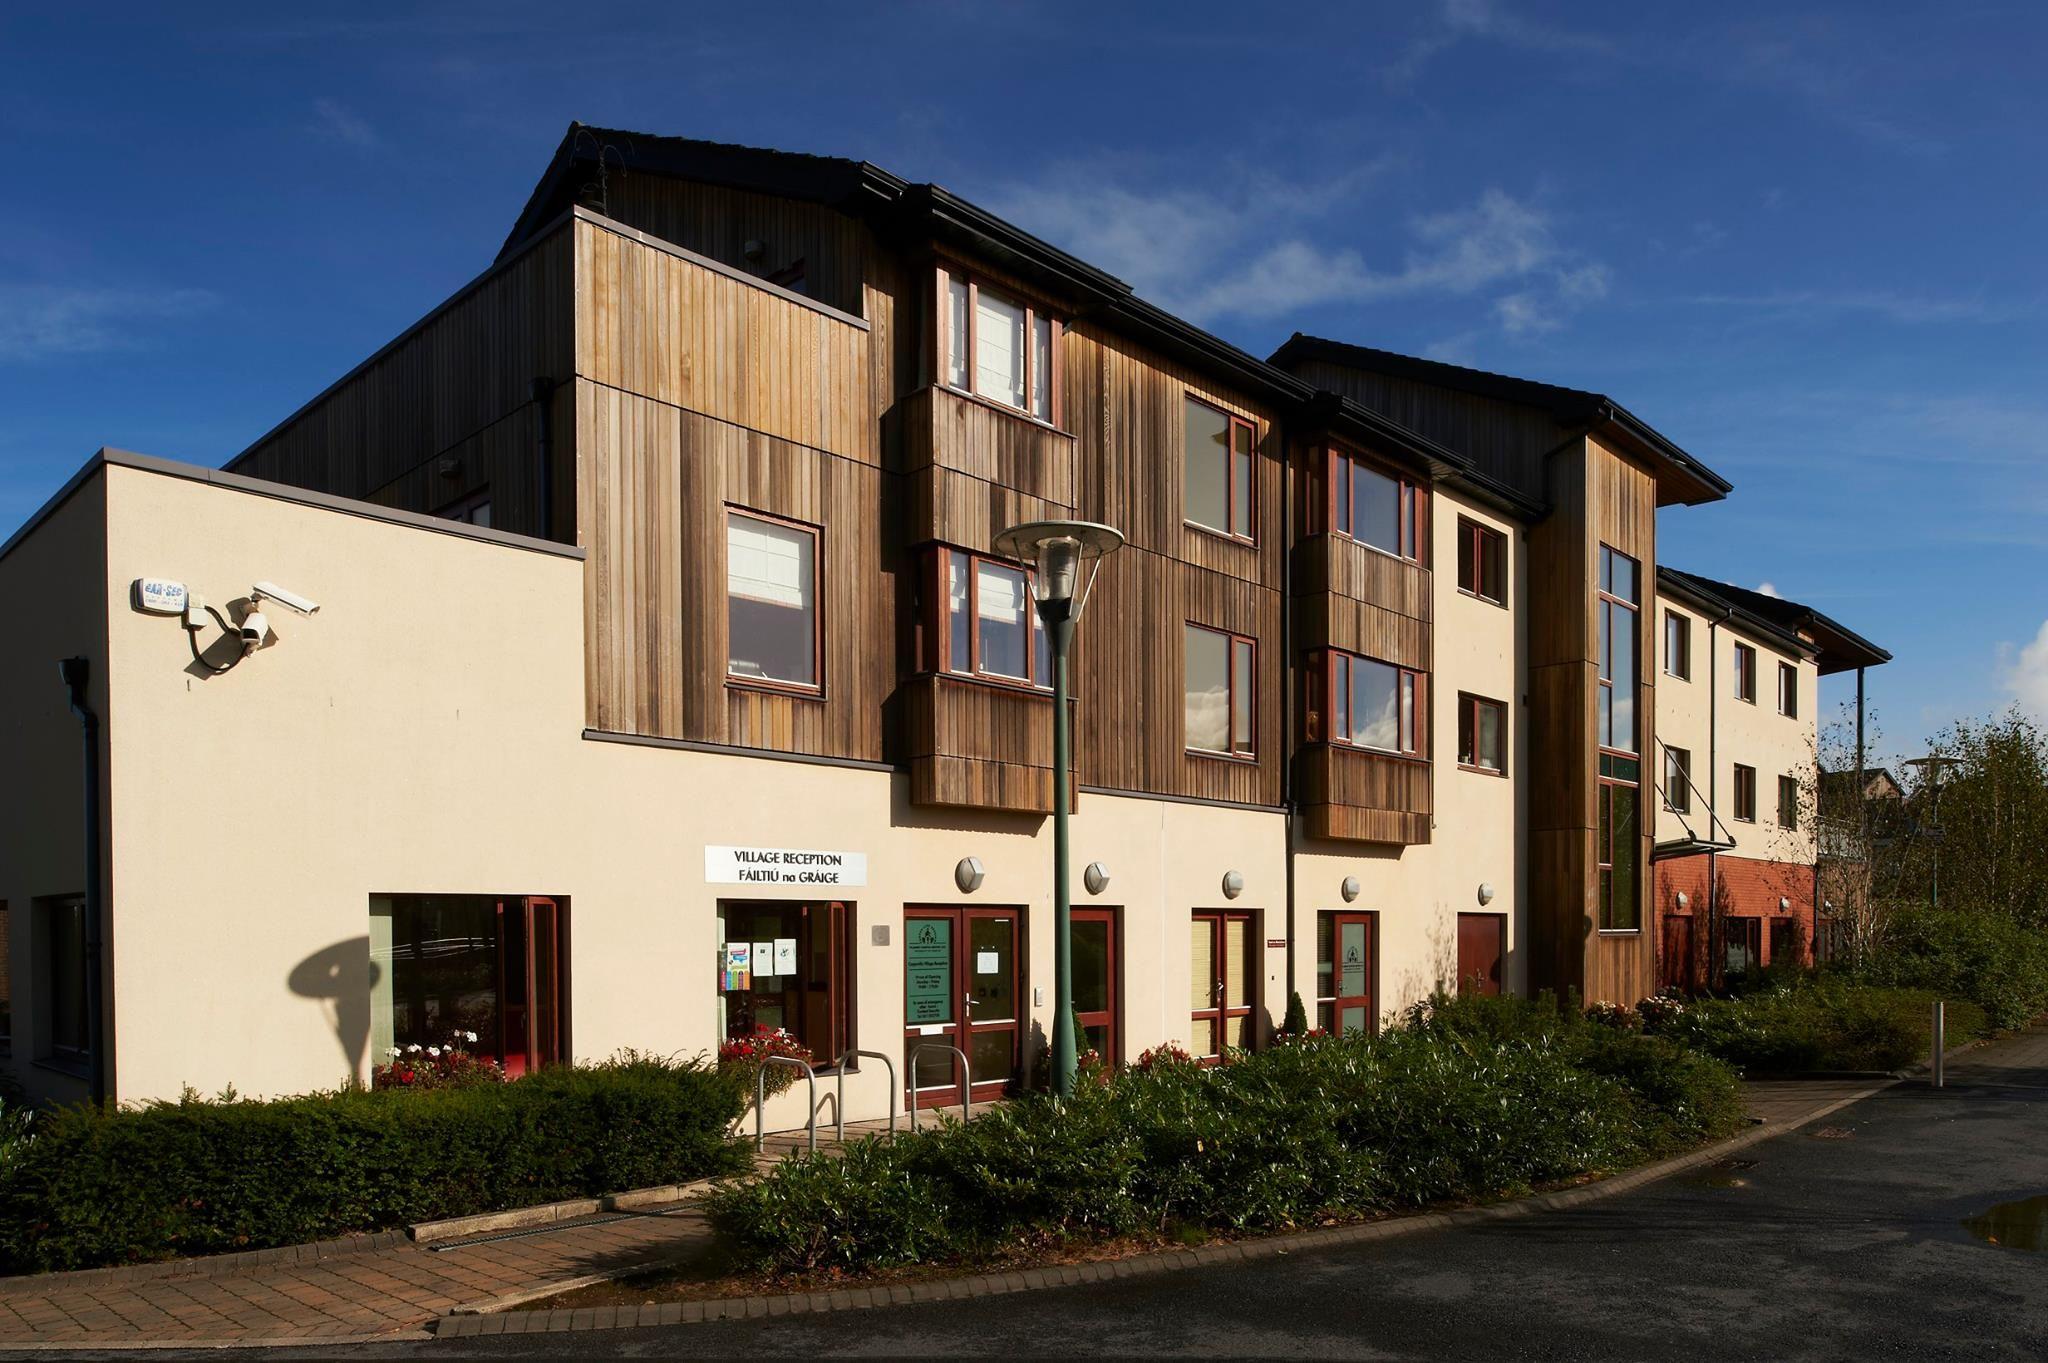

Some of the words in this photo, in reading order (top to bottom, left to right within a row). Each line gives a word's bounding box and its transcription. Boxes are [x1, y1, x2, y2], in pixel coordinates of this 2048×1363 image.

[734, 850, 780, 864] VILLAGE
[783, 853, 842, 866] RECEPTION
[738, 867, 779, 882] FÁILTIÚ
[782, 873, 796, 883] na
[798, 869, 840, 884] GRÁIGE
